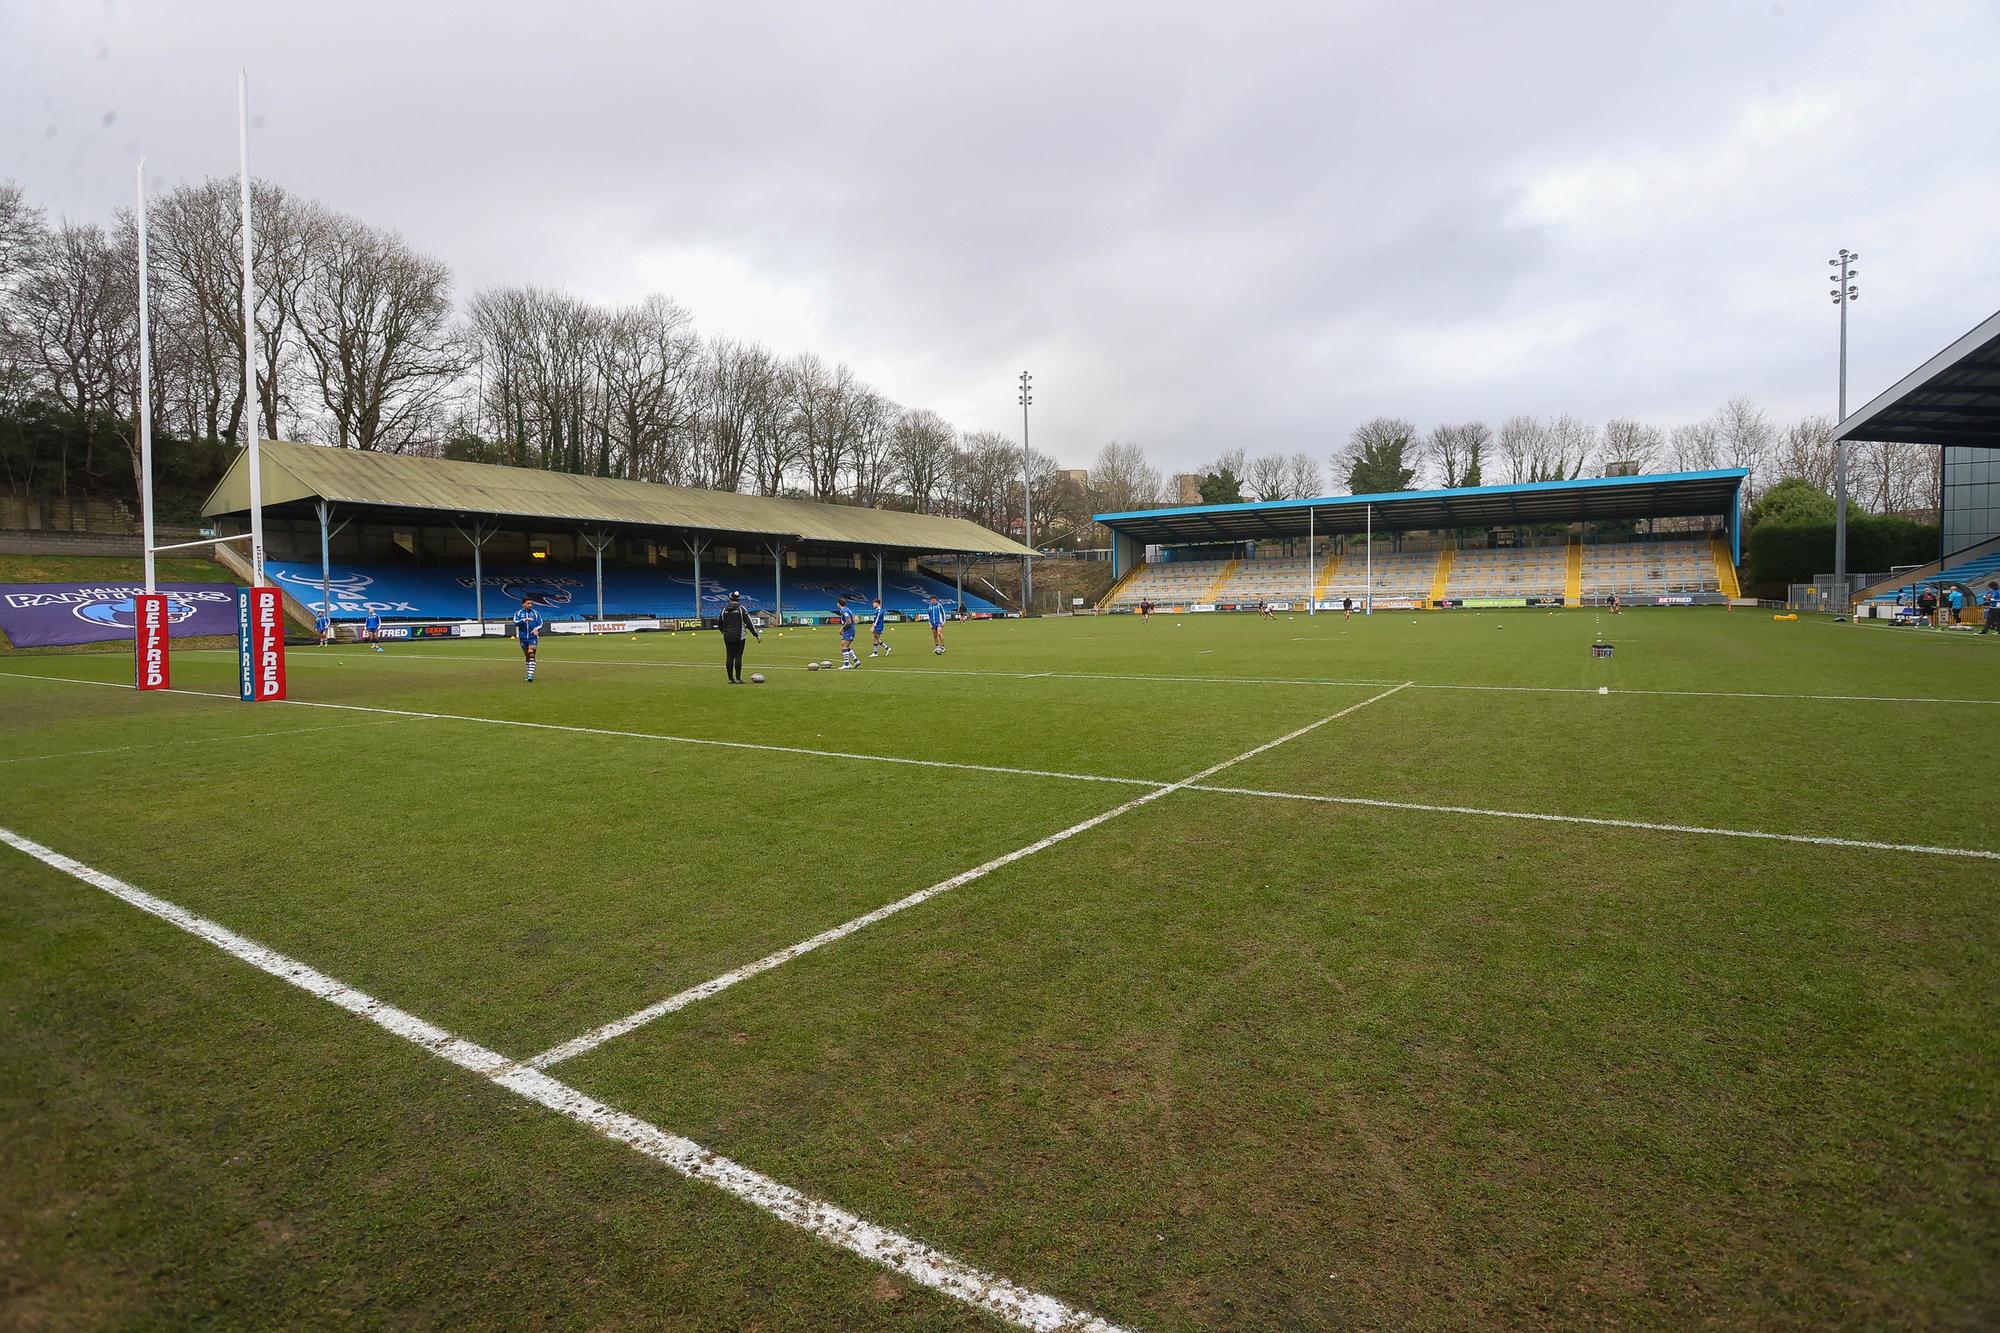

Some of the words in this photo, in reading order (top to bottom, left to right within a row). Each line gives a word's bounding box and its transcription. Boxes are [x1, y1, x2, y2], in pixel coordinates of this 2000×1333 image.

[145, 599, 163, 686] BETFRED
[240, 594, 252, 696] BETFRED
[258, 593, 279, 696] BETFRED
[362, 628, 408, 638] BTFRED
[592, 623, 627, 632] COLLETT
